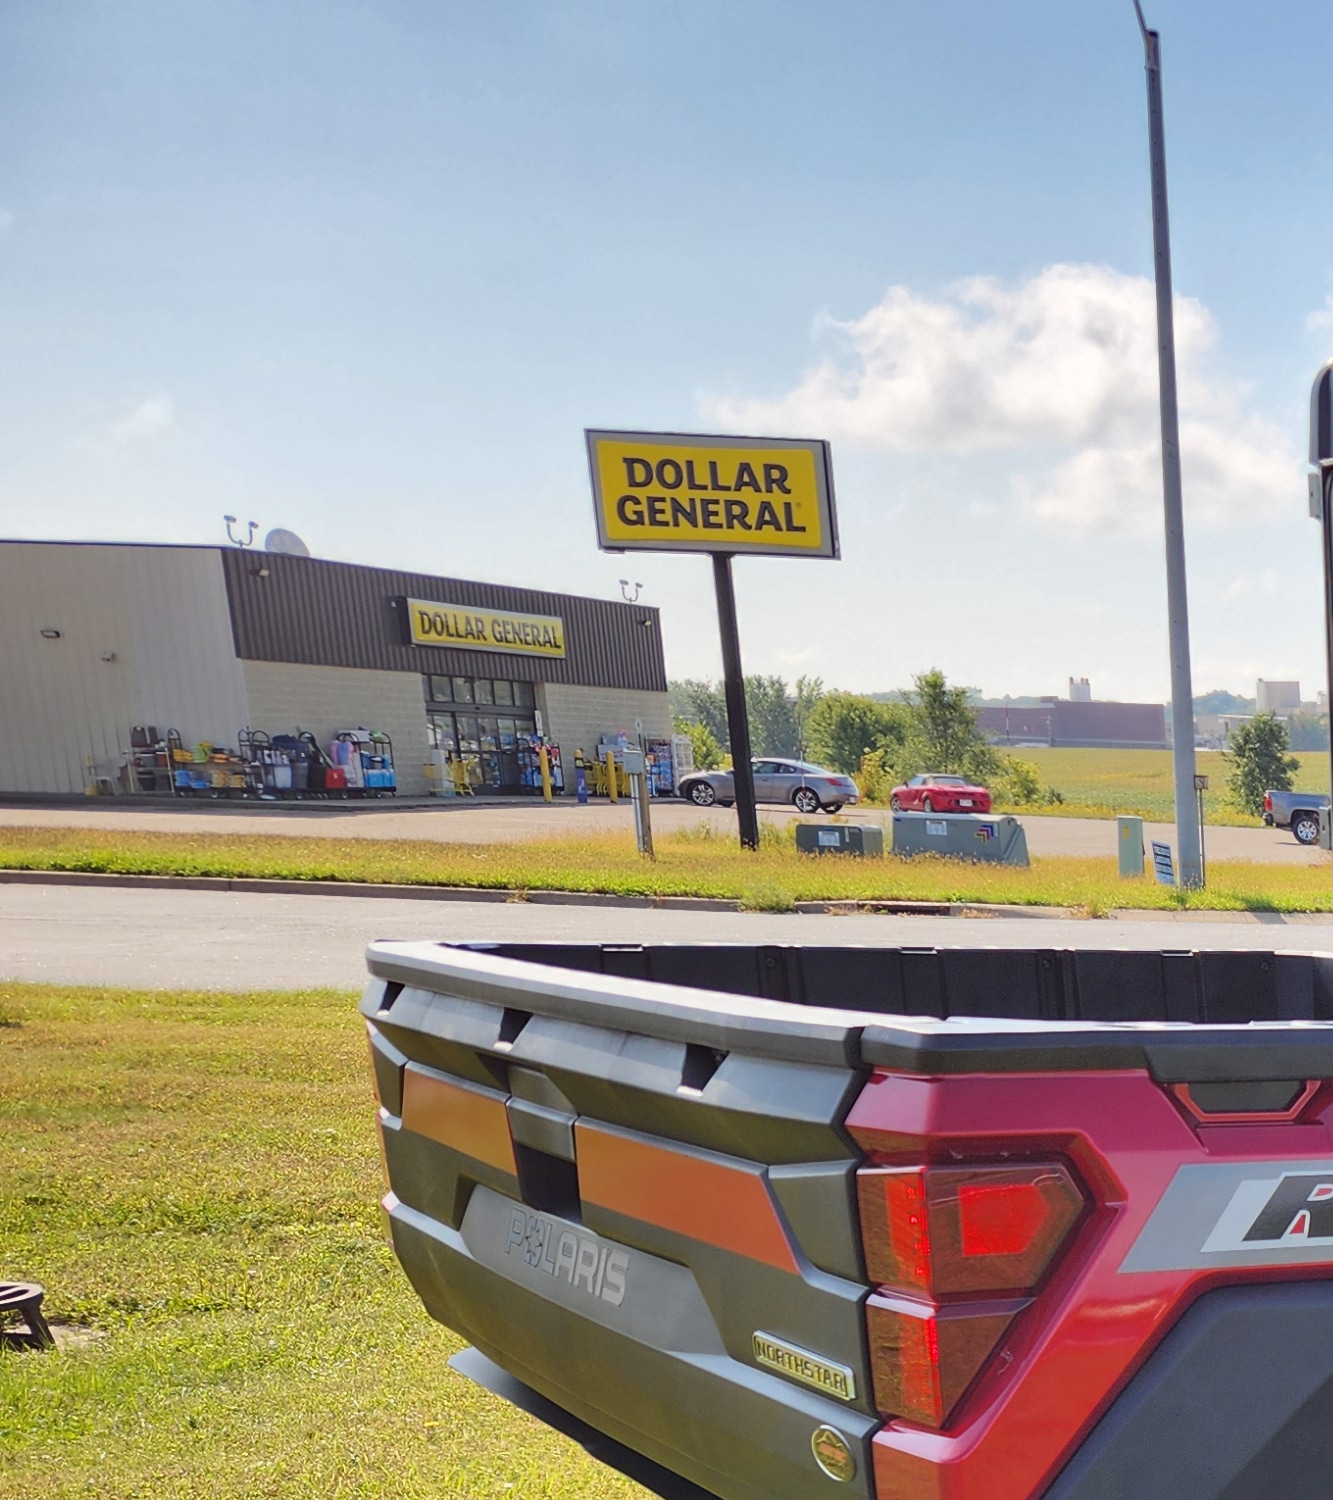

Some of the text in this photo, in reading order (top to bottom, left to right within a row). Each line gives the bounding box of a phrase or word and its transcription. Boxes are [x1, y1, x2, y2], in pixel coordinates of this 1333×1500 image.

[622, 457, 791, 494] DOLLAR
[616, 495, 806, 532] GENERAL
[418, 610, 562, 648] DOLLAR GENERAL
[504, 1206, 630, 1307] POLARIS
[756, 1340, 846, 1392] NORTHSTAR
